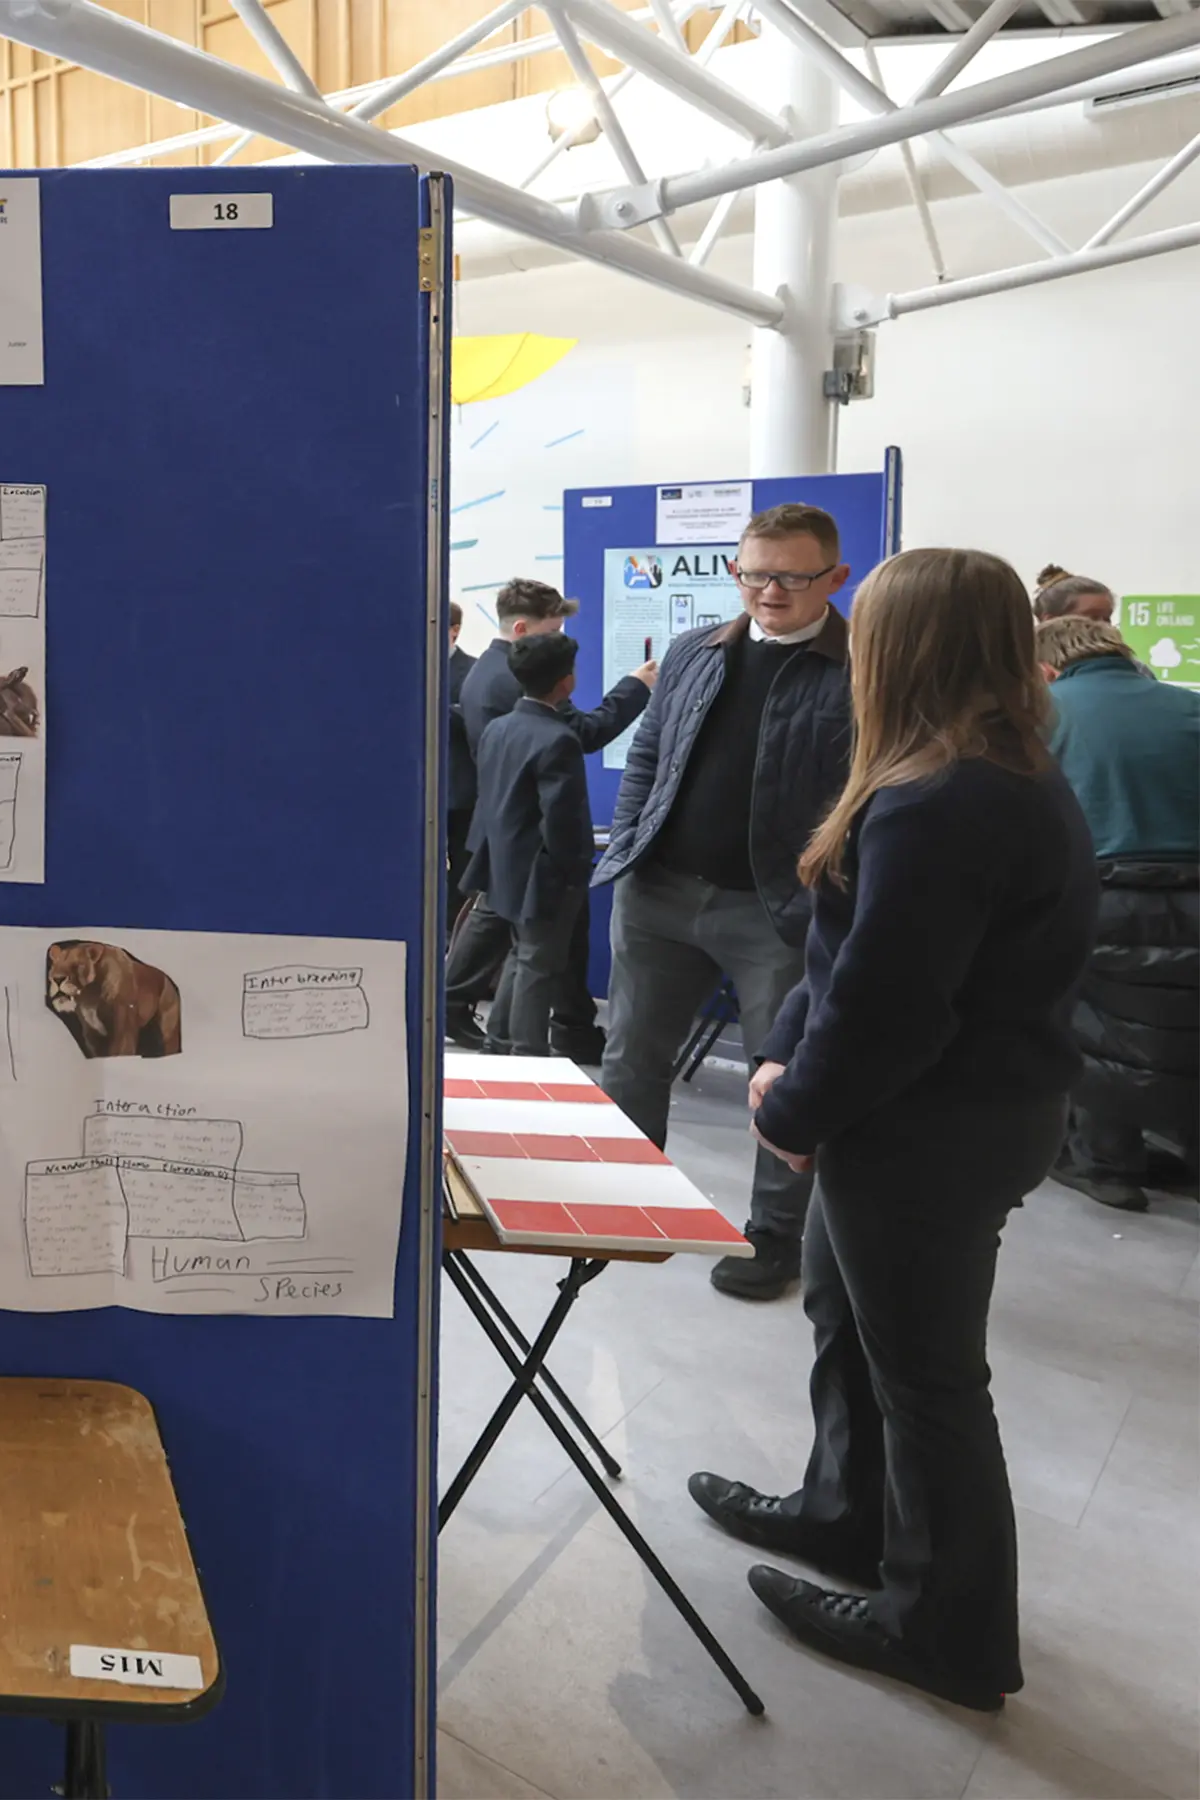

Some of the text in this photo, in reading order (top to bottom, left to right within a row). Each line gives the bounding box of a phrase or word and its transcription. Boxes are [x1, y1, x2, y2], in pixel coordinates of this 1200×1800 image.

[213, 203, 239, 220] 18
[1128, 602, 1150, 626] 15
[152, 1246, 250, 1278] Human
[99, 1654, 165, 1677] M15
